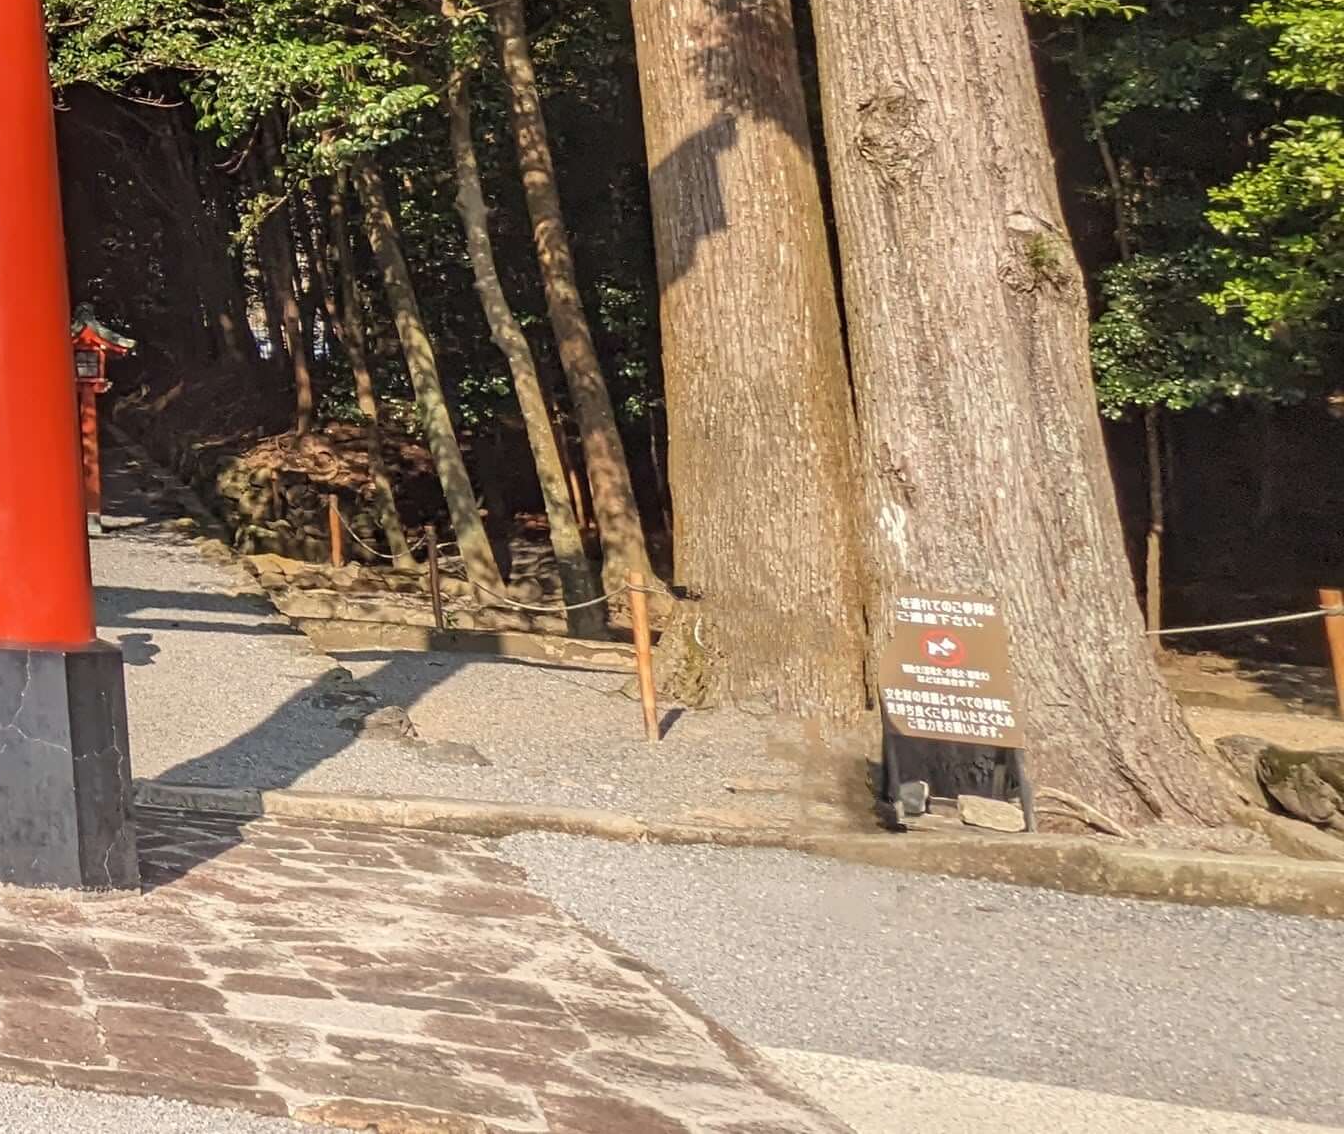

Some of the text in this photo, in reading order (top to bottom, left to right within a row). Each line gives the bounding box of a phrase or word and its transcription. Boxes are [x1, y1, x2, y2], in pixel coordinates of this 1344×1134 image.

[896, 597, 995, 616] を連れてのご参拝は
